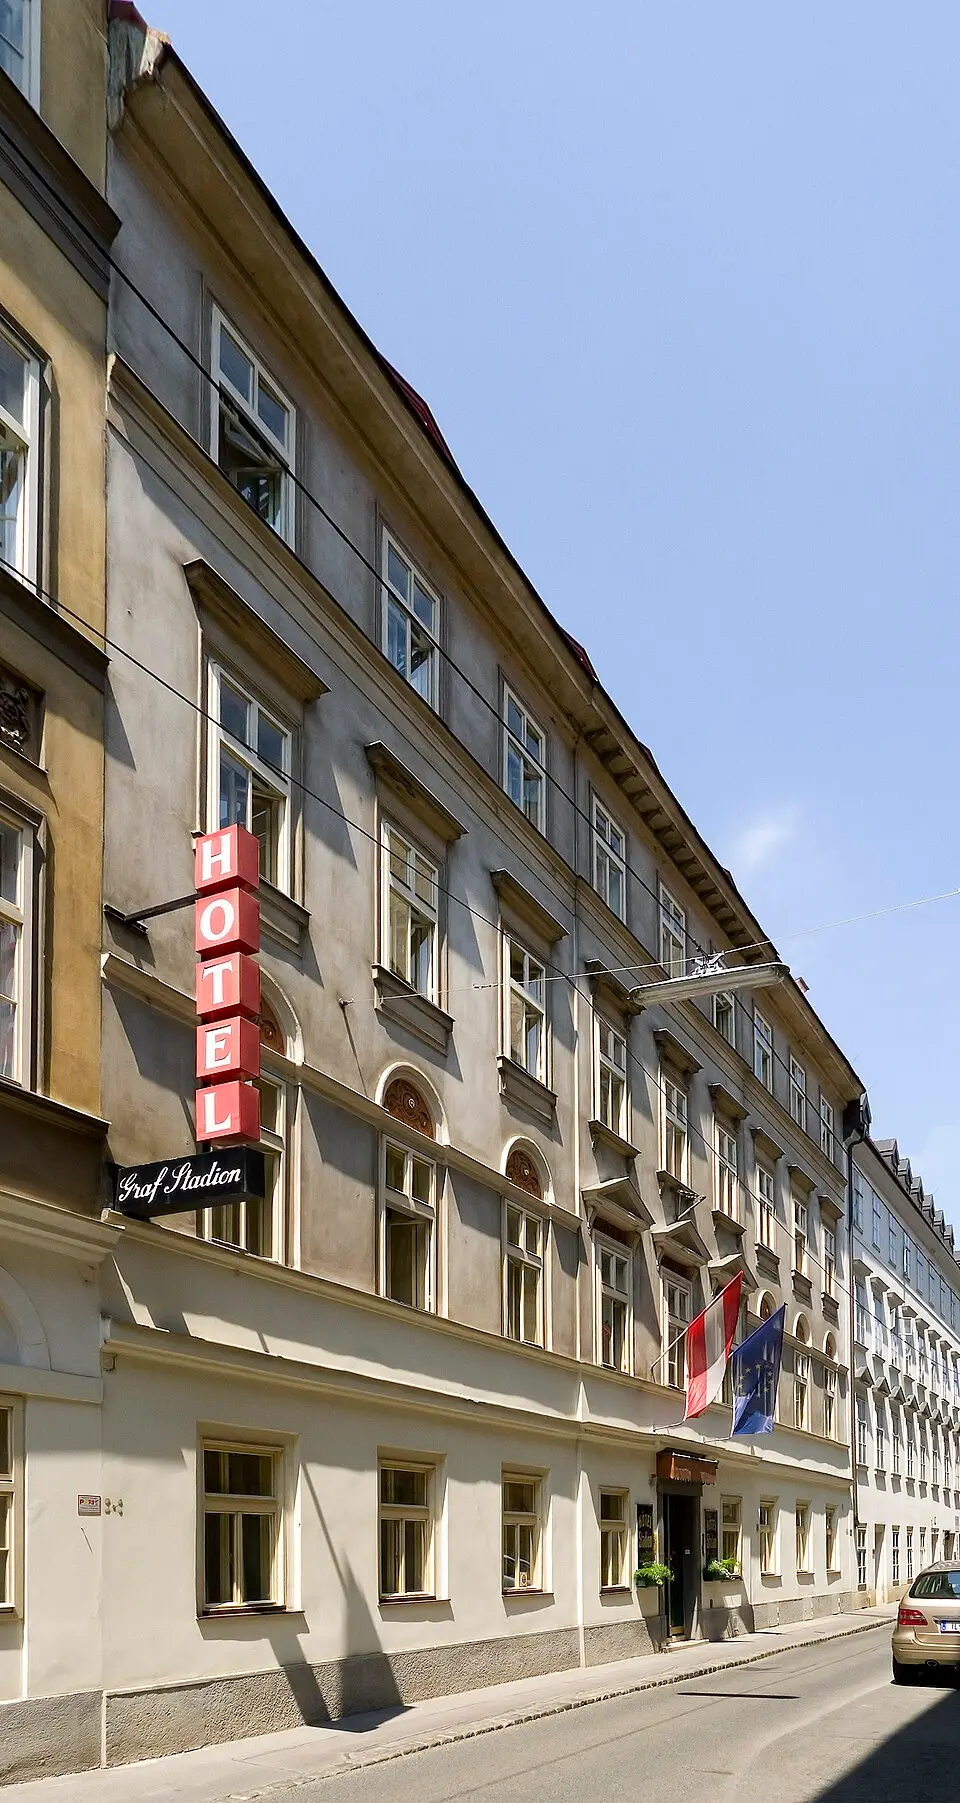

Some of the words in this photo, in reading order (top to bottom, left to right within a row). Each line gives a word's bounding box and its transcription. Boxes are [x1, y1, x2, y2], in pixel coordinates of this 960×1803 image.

[200, 833, 234, 1134] HOTEL
[119, 1173, 168, 1203] Graf
[164, 1161, 241, 1193] Stadion
